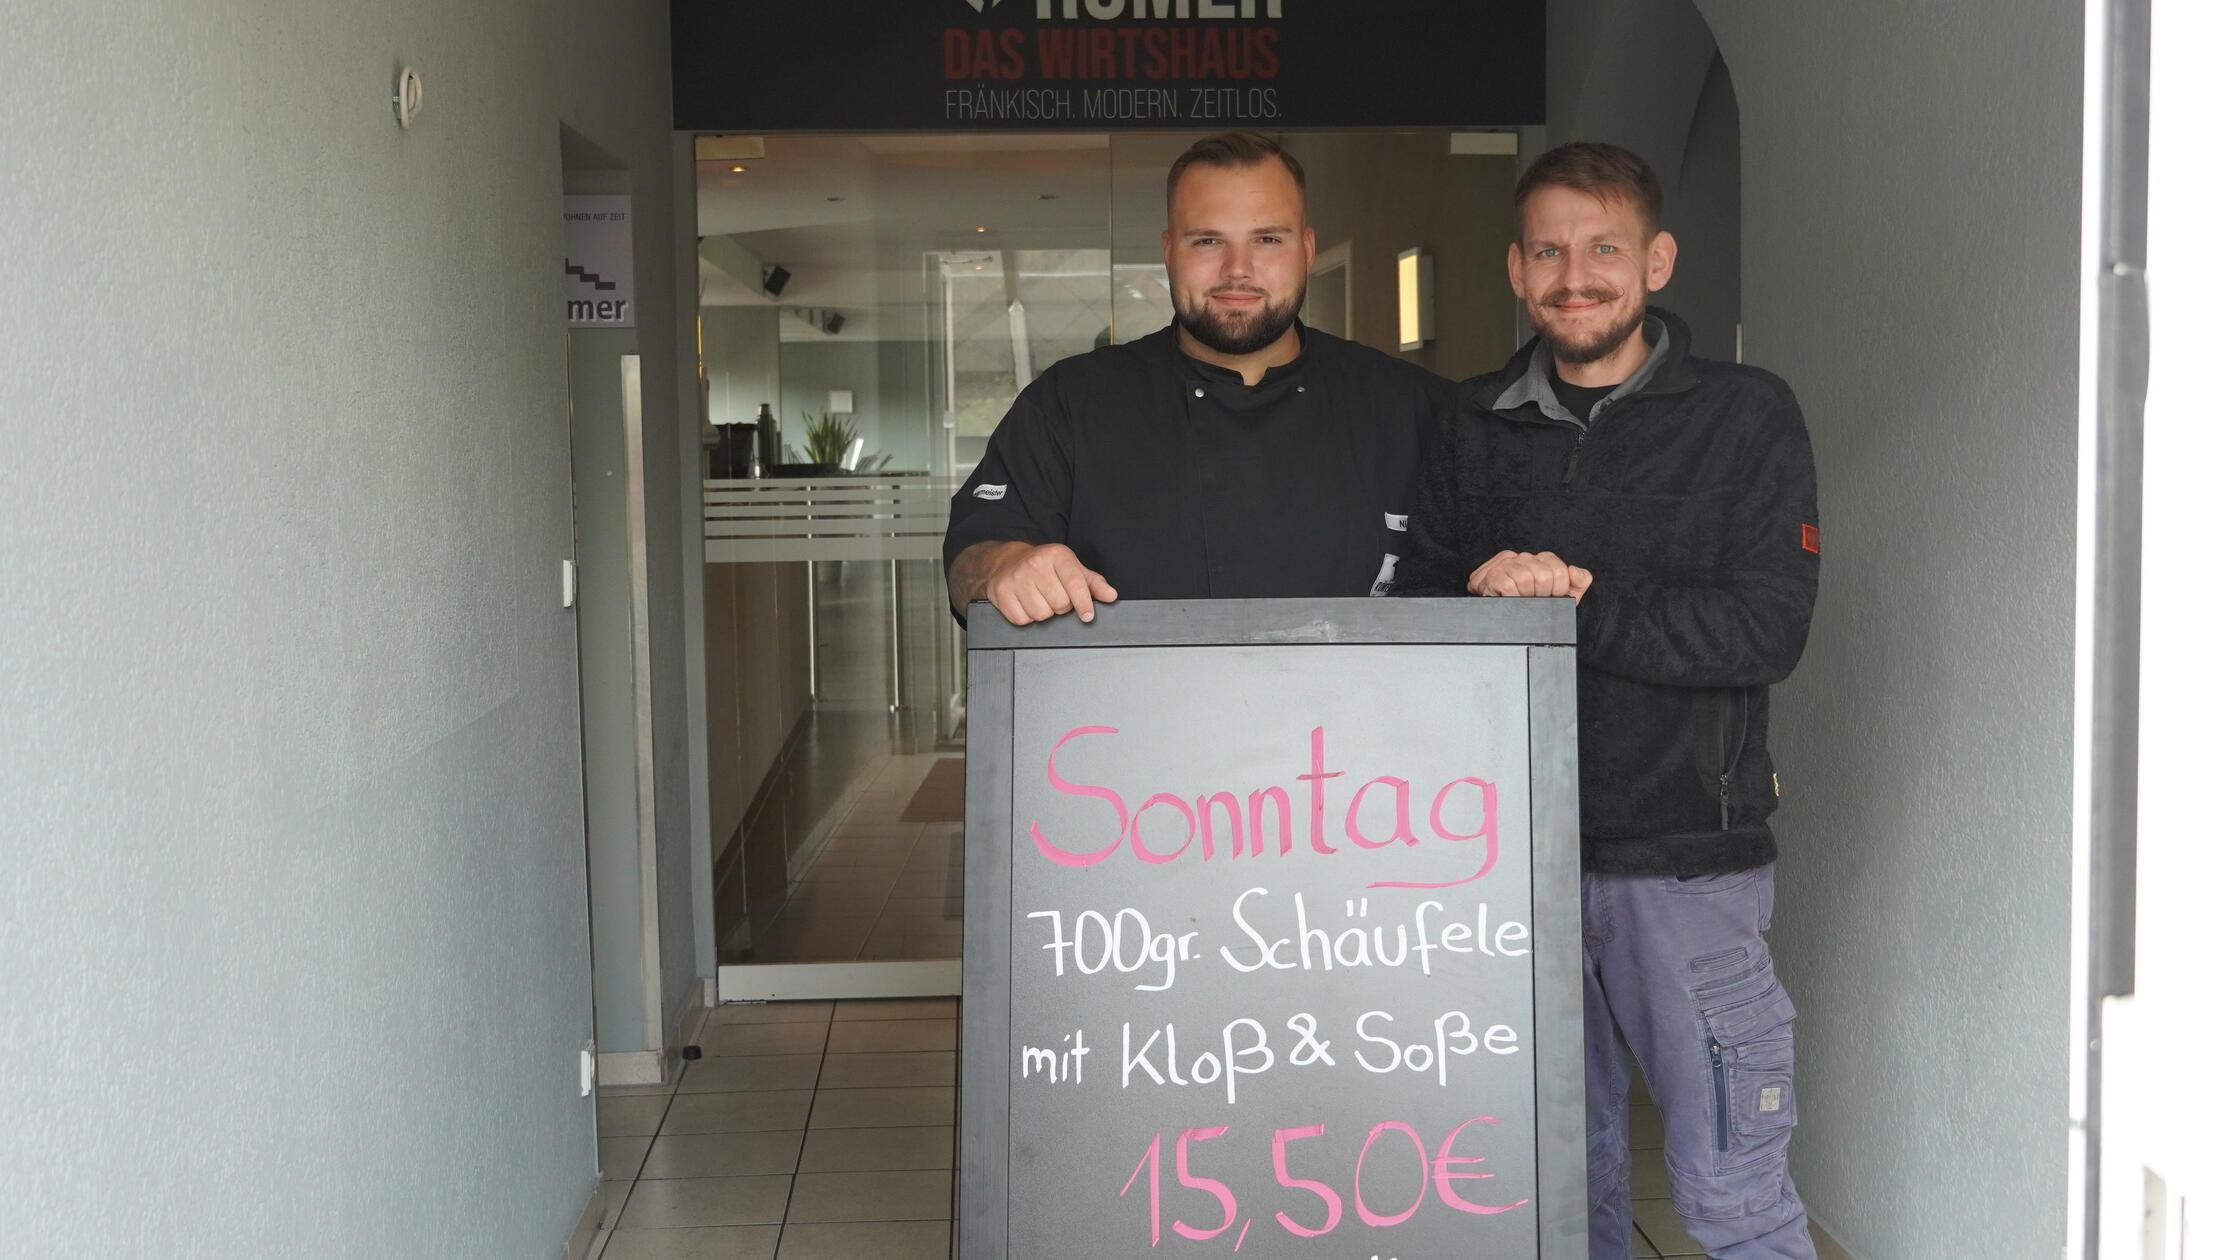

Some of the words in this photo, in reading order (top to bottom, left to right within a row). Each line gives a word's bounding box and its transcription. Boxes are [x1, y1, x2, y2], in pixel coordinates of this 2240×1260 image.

[943, 28, 1025, 80] DAS
[1035, 28, 1281, 80] WIRTSHAUS
[945, 84, 1076, 120] FRÄNKISCH.
[1084, 89, 1183, 120] MODERN.
[1190, 88, 1283, 119] ZEITLOS.
[593, 212, 608, 221] AUF
[609, 212, 625, 221] ZEIT
[1030, 725, 1499, 890] Sonntag
[1027, 908, 1201, 991] 700gr.
[1219, 887, 1531, 976] Schäufele
[1022, 1028, 1091, 1085] mit
[1121, 1017, 1275, 1104] Kloß
[1286, 1012, 1336, 1068] &
[1353, 1010, 1520, 1087] Soße
[1119, 1115, 1529, 1252] 15,50€
